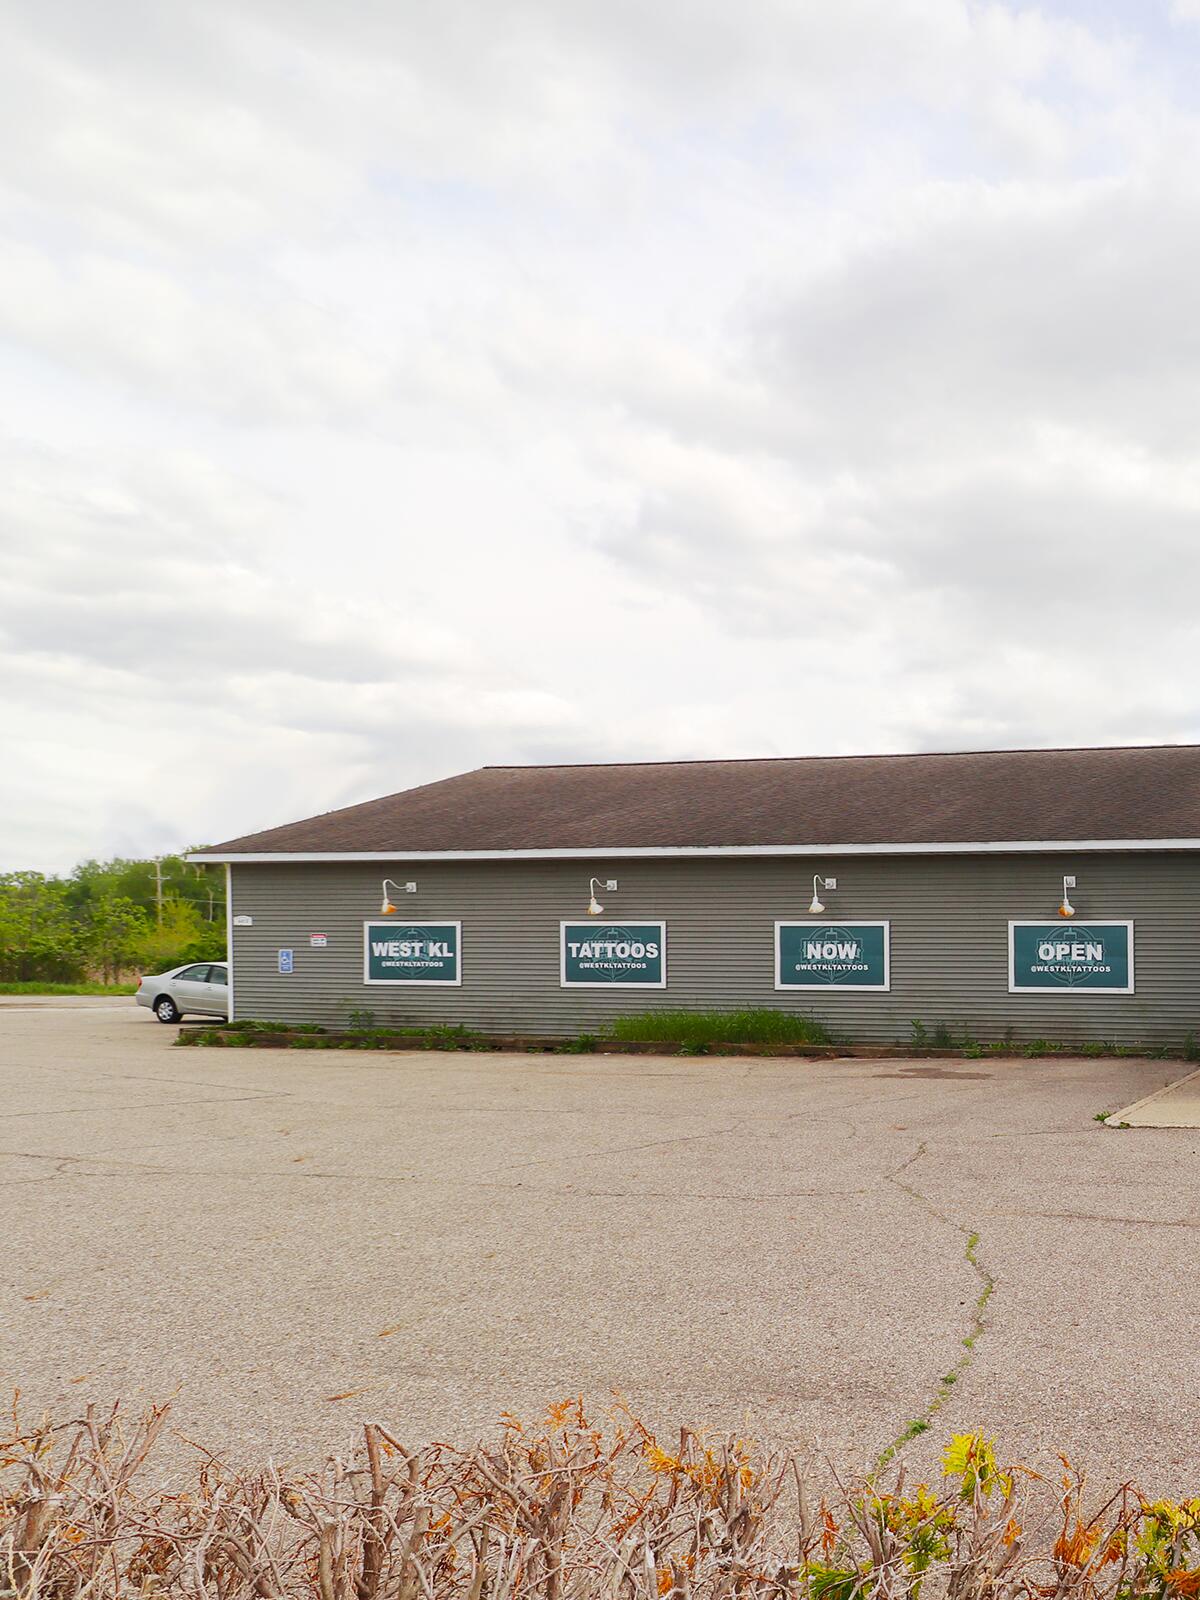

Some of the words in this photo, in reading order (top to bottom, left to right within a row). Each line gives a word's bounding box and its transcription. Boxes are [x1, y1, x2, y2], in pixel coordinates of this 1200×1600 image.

[371, 942, 424, 957] WEST
[428, 942, 454, 957] KL
[567, 942, 659, 959] TATTOOS
[806, 943, 857, 960] NOW
[1038, 943, 1103, 961] OPEN
[795, 963, 869, 971] @WESTKLTATTOOS
[1031, 965, 1111, 973] @WESTKLTATTOOS
